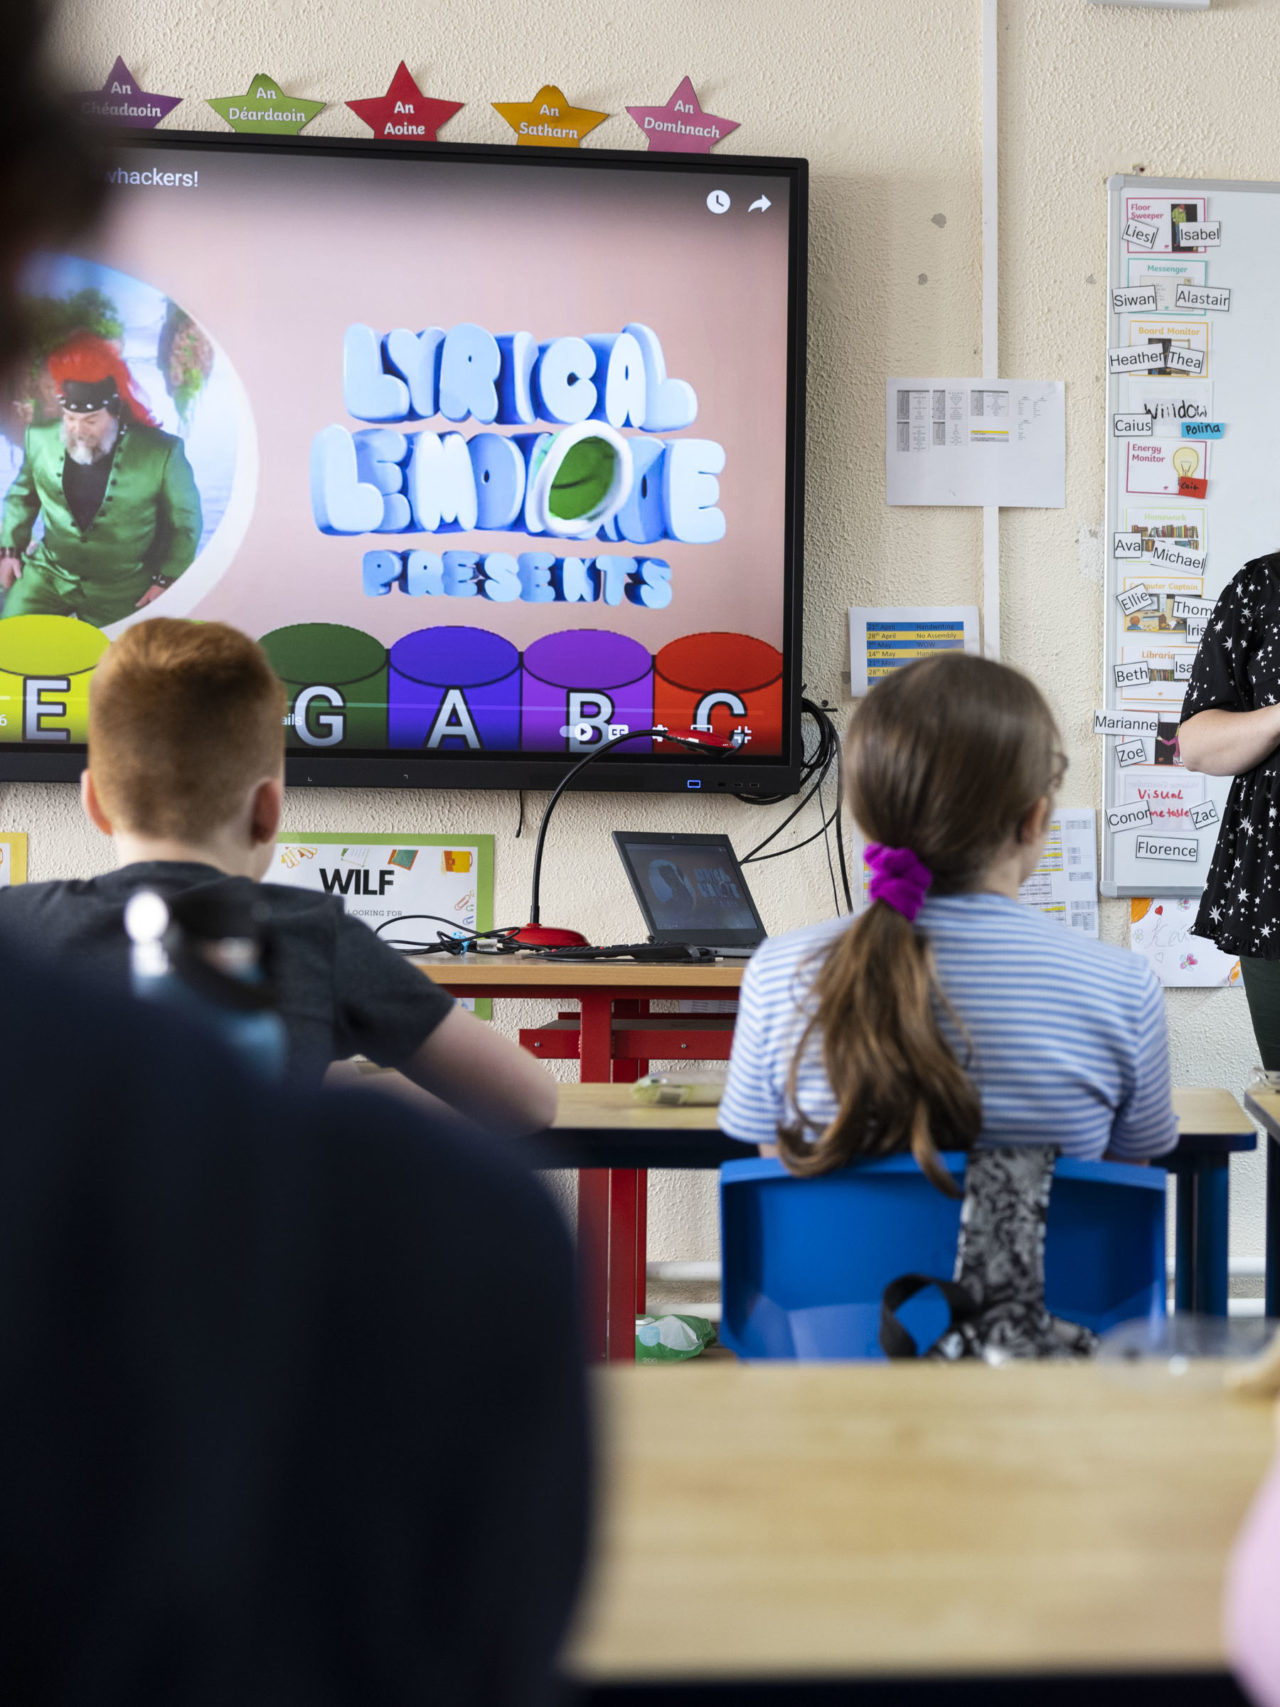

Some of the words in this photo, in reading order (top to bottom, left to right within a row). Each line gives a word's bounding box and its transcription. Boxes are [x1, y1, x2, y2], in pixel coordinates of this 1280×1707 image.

[110, 82, 132, 94] An
[256, 87, 276, 100] An
[82, 102, 162, 117] Chéadaoin
[229, 107, 306, 122] Déardaoin
[394, 101, 414, 115] An
[539, 103, 559, 117] An
[674, 100, 694, 115] An
[384, 121, 425, 136] Aoine
[519, 122, 578, 139] Satharn
[644, 116, 720, 139] Domhnach
[1131, 203, 1151, 211] Floor
[1131, 212, 1164, 221] Sweeper
[1125, 224, 1156, 244] Liesl
[1180, 228, 1220, 241] Isabel
[1147, 264, 1188, 275] Messenger
[1114, 294, 1155, 307] Siwan
[1177, 290, 1229, 307] Alastair
[1138, 327, 1164, 335] Board
[1167, 328, 1200, 336] Monitor
[1110, 351, 1166, 367] Heather
[1169, 351, 1201, 369] Thea
[343, 323, 698, 432] LYRICAL
[1115, 419, 1151, 432] Caius
[1185, 422, 1221, 435] Polina
[1132, 443, 1162, 454] Energy
[1132, 454, 1165, 463] Monitor
[1115, 540, 1140, 551] Ava
[1152, 547, 1205, 570] Michael
[363, 548, 672, 609] PRESENTS
[1121, 591, 1149, 611] Ellie
[1174, 601, 1213, 617] Thom
[881, 632, 896, 640] April
[881, 651, 896, 660] May
[1116, 667, 1148, 683] Beth
[23, 677, 71, 741] E
[294, 685, 346, 747] G
[424, 688, 483, 749] A
[567, 690, 616, 752] B
[1095, 715, 1158, 731] Marianne
[1119, 748, 1145, 762] Zoe
[1108, 808, 1151, 826] Conor
[1192, 808, 1217, 825] Zac
[1138, 841, 1197, 858] Florence
[319, 868, 395, 895] WILF
